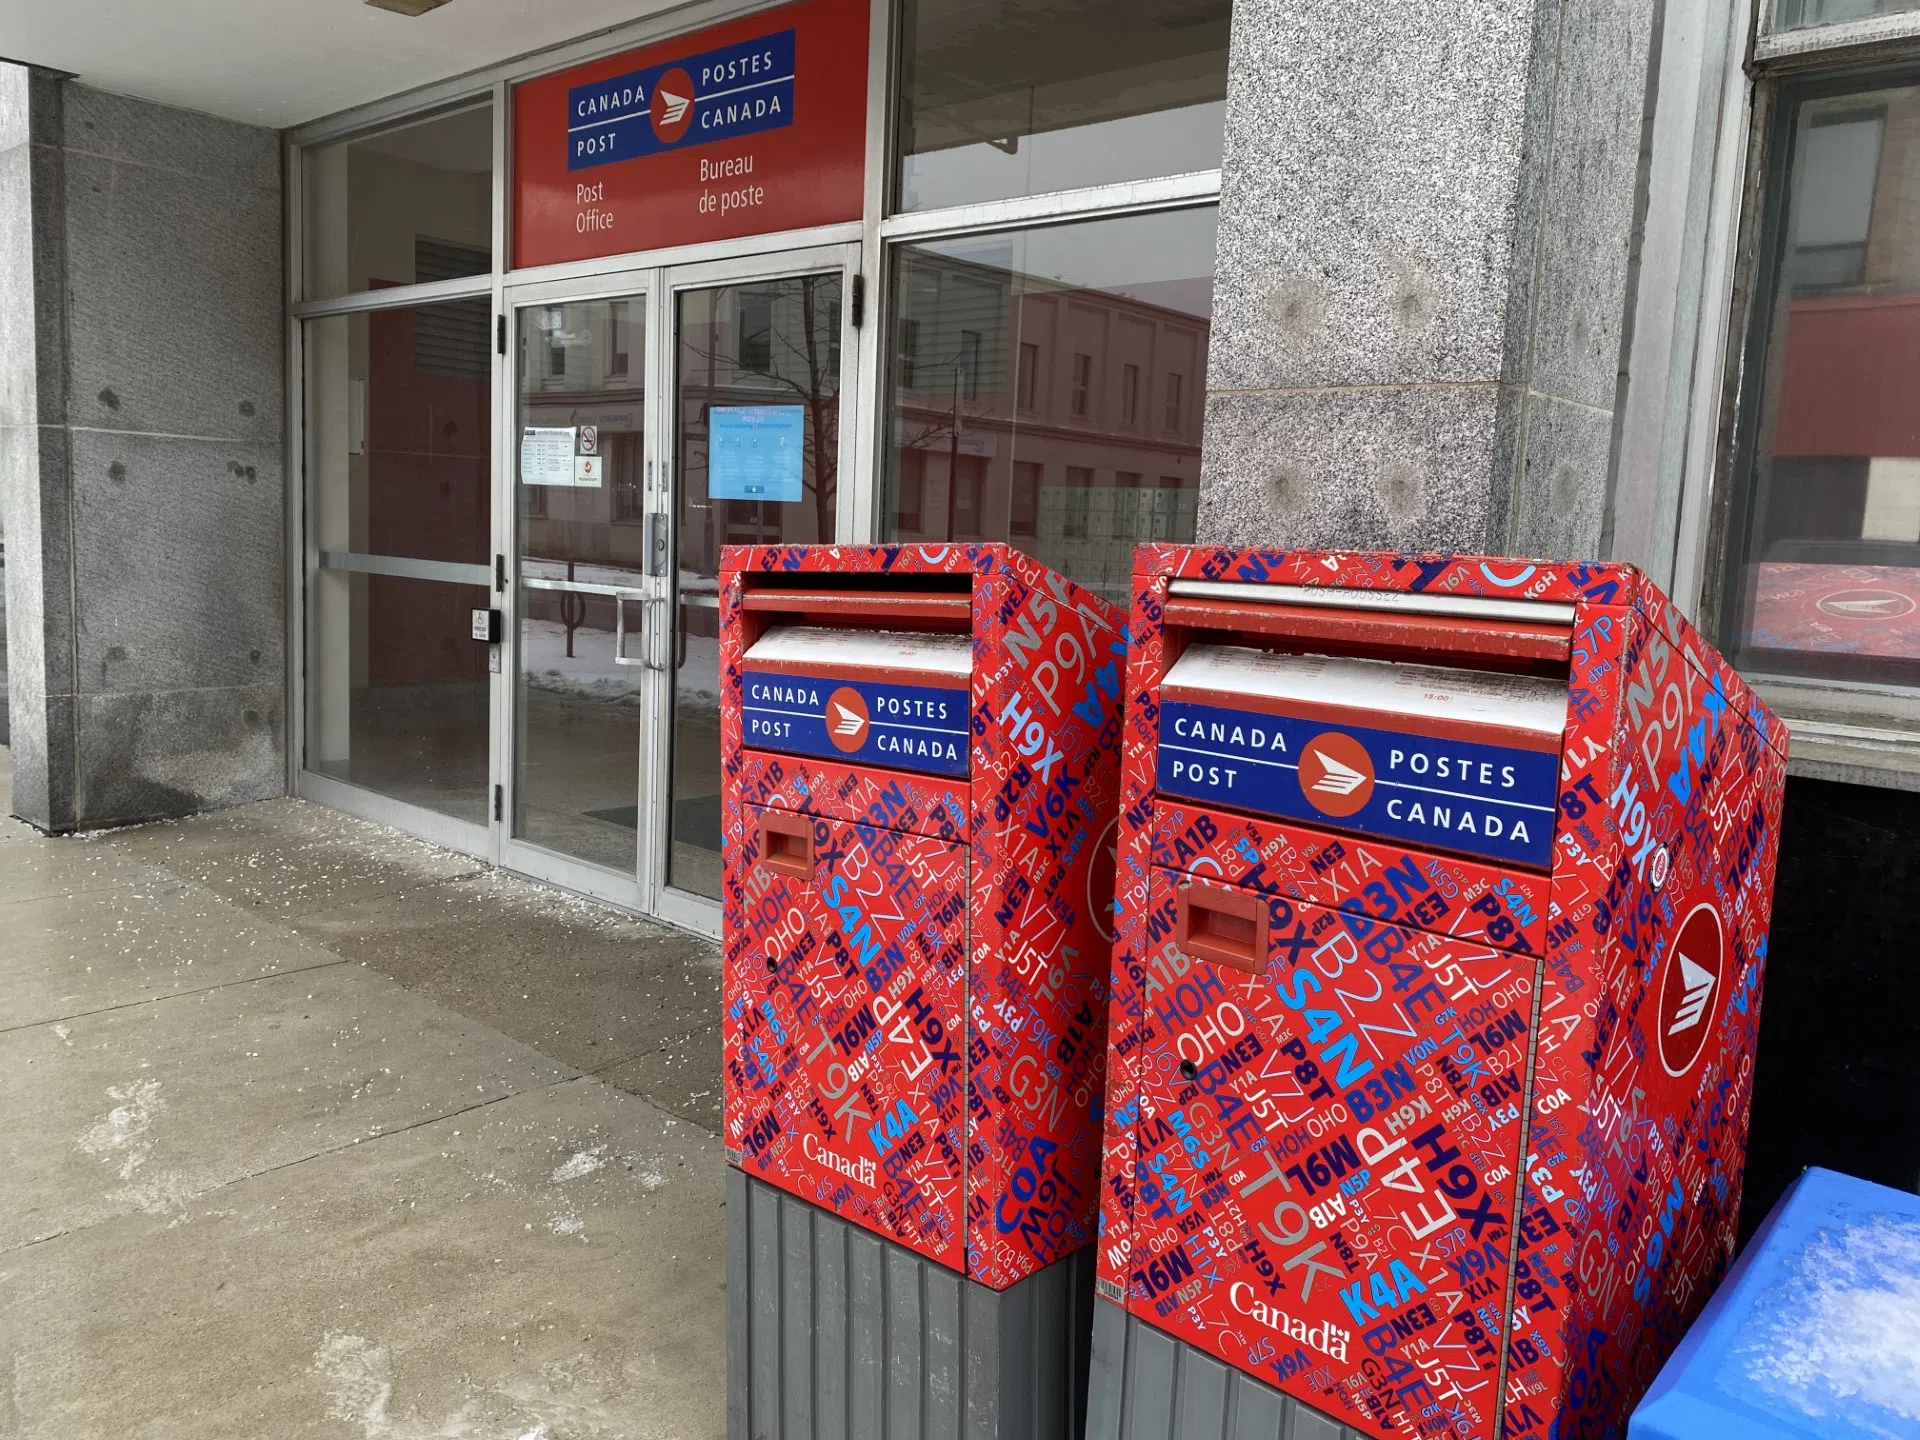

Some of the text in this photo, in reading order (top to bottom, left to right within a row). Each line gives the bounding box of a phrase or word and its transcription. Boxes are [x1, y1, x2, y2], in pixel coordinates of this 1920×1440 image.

[702, 51, 773, 86] POSTES
[578, 84, 646, 117] CANADA
[701, 95, 781, 129] CANADA
[577, 133, 616, 157] POST
[700, 155, 753, 182] Bureau
[576, 181, 604, 204] Post
[698, 184, 764, 216] de poste
[576, 208, 614, 234] Office
[944, 550, 962, 573] K6H
[1438, 566, 1471, 592] V9L
[1524, 570, 1557, 599] K6H
[1031, 603, 1117, 717] P9A
[751, 684, 820, 706] CANADA
[877, 697, 948, 720] POSTES
[1424, 693, 1450, 702] 15:00
[1642, 643, 1708, 792] P9A
[752, 720, 791, 738] POST
[877, 735, 958, 760] CANADA
[999, 691, 1064, 786] H9X
[1174, 718, 1287, 752] CANADA
[757, 761, 783, 802] A1B
[1172, 760, 1238, 788] POST
[1390, 750, 1516, 787] POSTES
[845, 777, 879, 820] X1A
[855, 780, 907, 849] B3N
[942, 791, 968, 828] S4N
[1026, 761, 1080, 839] V6K
[1386, 799, 1531, 844] CANADA
[1611, 762, 1656, 883] H9X
[929, 804, 966, 853] P8T
[995, 812, 1039, 878] X1A
[1173, 814, 1219, 866] A1B
[1261, 834, 1288, 861] K6H
[1558, 832, 1593, 867] P3Y
[871, 834, 919, 910] B4E
[905, 853, 938, 889] J5T
[1309, 840, 1346, 876] E3N
[1320, 847, 1383, 902] X1A
[1656, 855, 1666, 879] STOP
[800, 881, 828, 932] X1A
[821, 875, 881, 968] S4N
[932, 891, 965, 929] M9L
[993, 874, 1032, 929] E3N
[1338, 854, 1431, 941] B3N
[1396, 891, 1450, 940] E3N
[1492, 877, 1539, 928] S4N
[790, 931, 816, 966] E3N
[918, 907, 946, 956] T9K
[1445, 907, 1512, 988] V7J
[1470, 892, 1533, 959] P8T
[825, 930, 859, 980] P8T
[865, 941, 905, 993] B3N
[941, 938, 965, 969] A1B
[947, 964, 965, 988] P3Y
[1008, 940, 1049, 986] J5T
[1144, 941, 1191, 1003] A1B
[1363, 926, 1447, 1023] B4E
[1424, 953, 1480, 1001] J5T
[776, 956, 818, 1026] B4E
[806, 974, 833, 1009] J5T
[888, 966, 916, 1000] K6H
[1238, 974, 1285, 1037] X1A
[1312, 930, 1417, 1060] B2Z
[832, 1004, 876, 1057] M9L
[864, 1029, 883, 1054] N5P
[873, 996, 934, 1081] E4P
[905, 986, 961, 1076] H9X
[1276, 968, 1375, 1090] S4N
[1468, 1008, 1528, 1055] M9L
[750, 1036, 778, 1084] S4N
[848, 1051, 870, 1082] A1B
[1220, 1032, 1264, 1075] E3N
[1281, 1037, 1335, 1102] P8T
[1435, 1053, 1469, 1098] N8T
[1440, 1023, 1491, 1089] T9K
[806, 1023, 872, 1145] T9K
[928, 1076, 964, 1113] V6K
[1009, 1054, 1068, 1133] G3N
[1195, 1059, 1262, 1150] B4E
[1229, 1070, 1258, 1094] Y1A
[1260, 1049, 1315, 1123] V7J
[1344, 1060, 1417, 1124] B3N
[1415, 1063, 1454, 1105] P8T
[1480, 1069, 1522, 1108] A1B
[810, 1097, 837, 1142] H9X
[867, 1098, 919, 1157] K4A
[907, 1082, 940, 1137] X1A
[1244, 1088, 1288, 1132] J5T
[1384, 1095, 1434, 1137] K6H
[1487, 1103, 1521, 1132] P3Y
[1592, 1085, 1622, 1142] J5T
[743, 1110, 781, 1158] M9L
[899, 1130, 926, 1163] E3N
[935, 1132, 961, 1168] P8T
[1167, 1109, 1210, 1169] M6S
[1188, 1102, 1240, 1171] G3N
[882, 1151, 927, 1221] B4E
[1148, 1152, 1193, 1214] S4N
[1285, 1133, 1361, 1196] M9L
[1339, 1168, 1372, 1199] N5P
[1356, 1127, 1457, 1241] E4P
[1411, 1123, 1507, 1241] H9X
[914, 1174, 943, 1207] J5T
[1309, 1192, 1346, 1229] A1B
[1208, 1210, 1244, 1252] P8T
[1239, 1149, 1347, 1304] T9K
[1131, 1244, 1195, 1299] M9L
[1245, 1238, 1287, 1298] H9X
[1409, 1241, 1464, 1315] X1A
[1447, 1240, 1509, 1286] V6K
[1338, 1258, 1428, 1327] K4A
[1390, 1302, 1438, 1340] E3N
[1453, 1309, 1498, 1359] P8T
[1529, 1330, 1551, 1357] G6X
[1362, 1323, 1435, 1413] B4E
[1416, 1357, 1464, 1401] J5T
[1433, 1322, 1489, 1392] V7J
[1361, 1357, 1399, 1410] G3N
